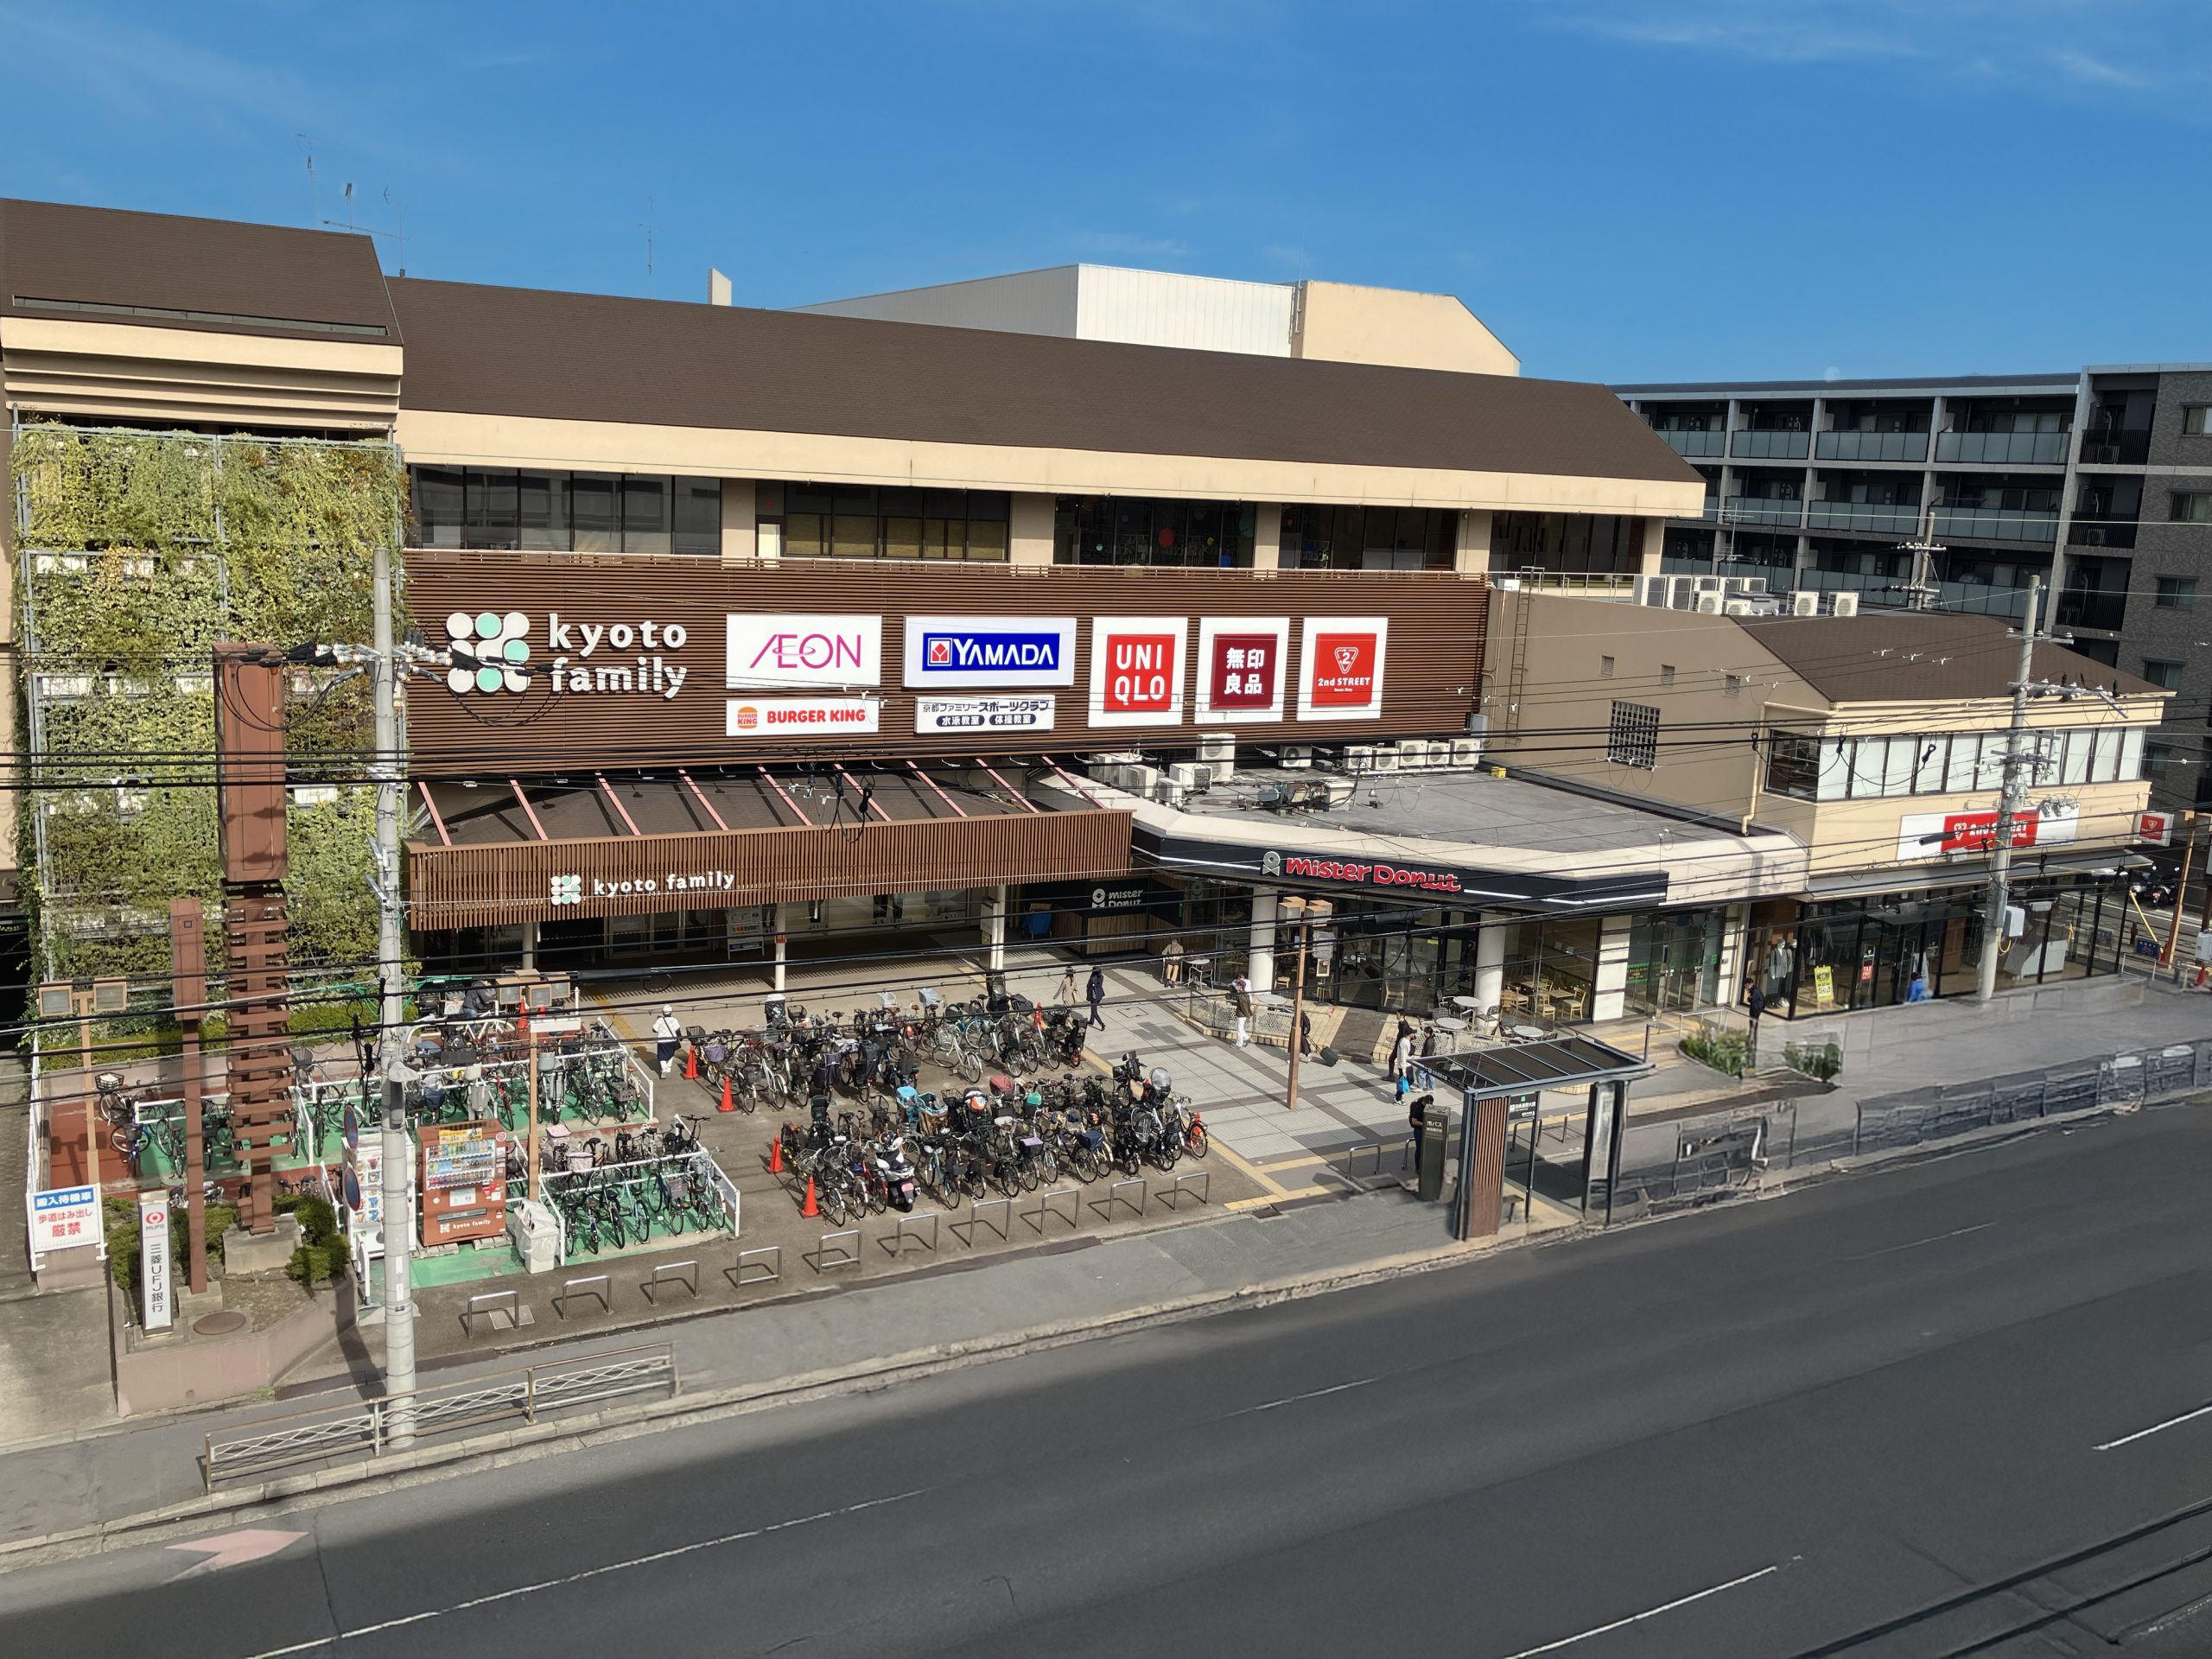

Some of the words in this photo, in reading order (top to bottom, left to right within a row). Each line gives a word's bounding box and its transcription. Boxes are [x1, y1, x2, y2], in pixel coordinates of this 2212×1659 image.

[549, 613, 687, 658] kyoto
[953, 638, 1054, 666] YAMADA
[1116, 644, 1162, 670] UNI
[1226, 647, 1265, 670] 無印
[550, 657, 687, 699] family
[1224, 673, 1262, 694] 良品
[1318, 677, 1336, 687] 2nd
[1337, 677, 1370, 686] STREET
[1114, 675, 1166, 706] QLO
[766, 710, 825, 724] BURGER
[829, 709, 866, 722] KING
[923, 700, 1050, 713] 京都ファミリースポーツクラブ
[942, 715, 980, 726] 水泳教室
[995, 715, 1032, 725] 体操教室
[594, 879, 657, 899] kyoto
[666, 871, 734, 890] family
[1286, 857, 1371, 882] mister
[1373, 865, 1461, 893] Donut
[1109, 889, 1143, 899] mister
[38, 1209, 92, 1224] 歩道はみ出し
[52, 1221, 81, 1237] 厳禁
[149, 1243, 163, 1313] 三菱UFJ銀行
